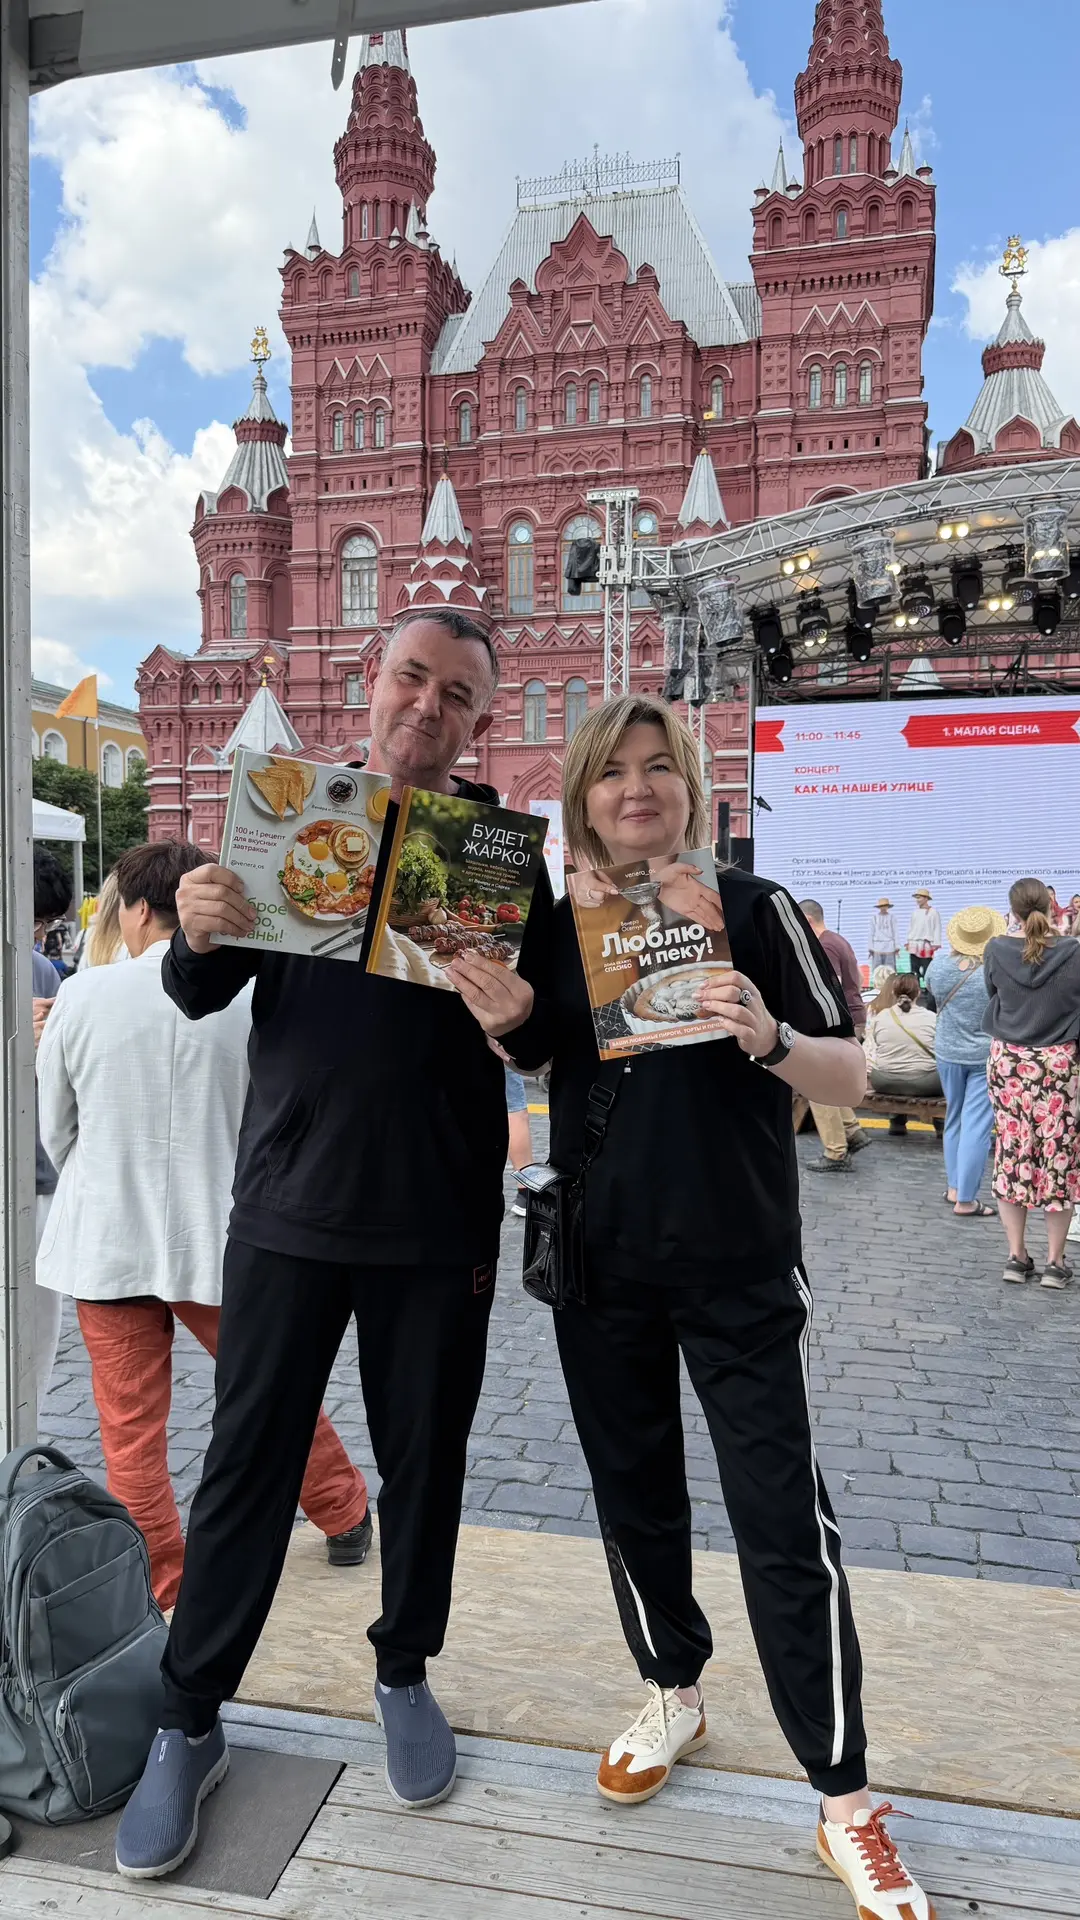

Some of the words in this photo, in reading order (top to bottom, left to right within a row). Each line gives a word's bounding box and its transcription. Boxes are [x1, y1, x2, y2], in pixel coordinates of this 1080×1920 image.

[796, 732, 823, 741] 11:00
[834, 730, 861, 740] 11:45
[942, 727, 951, 737] 1.
[954, 726, 996, 736] МАЛАЯ
[998, 724, 1040, 736] СЦЕНА
[794, 765, 840, 775] КОНЦЕРТ
[794, 785, 819, 795] КАК
[822, 784, 839, 794] НА
[842, 781, 888, 793] НАШЕЙ
[891, 782, 934, 793] УЛИЦЕ
[235, 826, 248, 835] 100
[255, 828, 259, 837] 1
[260, 831, 286, 841] рецепт
[472, 823, 529, 847] БУДЕТ
[233, 836, 247, 844] для
[248, 838, 278, 848] вкусных
[233, 844, 269, 854] завтраков
[461, 839, 531, 867] ЖАРКО!
[230, 859, 265, 870] @venera_os
[601, 922, 706, 958] Люблю
[638, 953, 651, 967] и
[655, 936, 714, 962] пеку!
[604, 963, 632, 973] СПАСИБО
